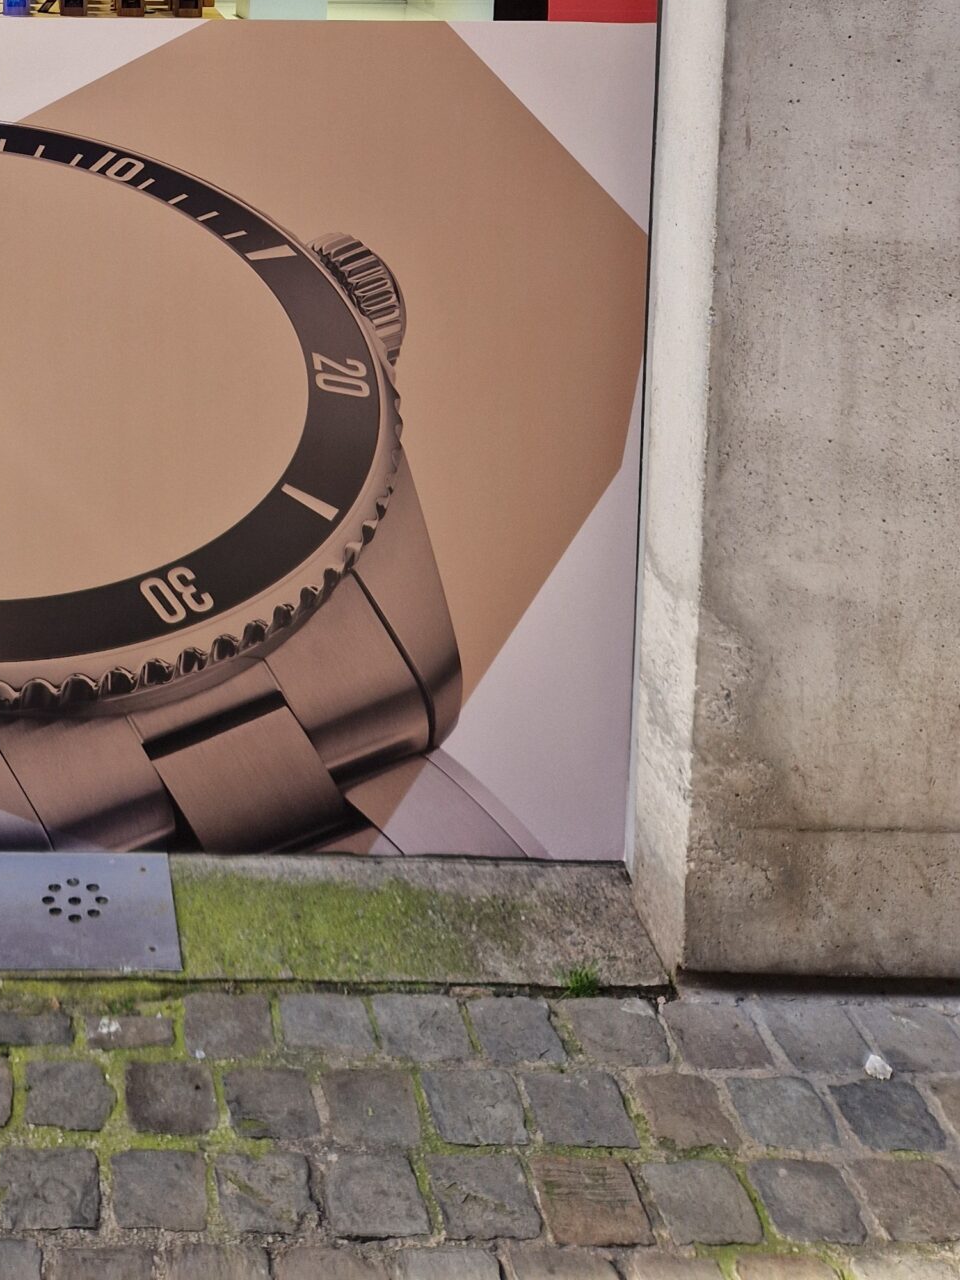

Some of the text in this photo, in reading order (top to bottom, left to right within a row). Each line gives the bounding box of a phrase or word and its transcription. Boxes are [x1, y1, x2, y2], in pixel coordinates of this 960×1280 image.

[89, 150, 145, 182] 10
[311, 351, 370, 398] 20
[140, 566, 214, 624] 30
